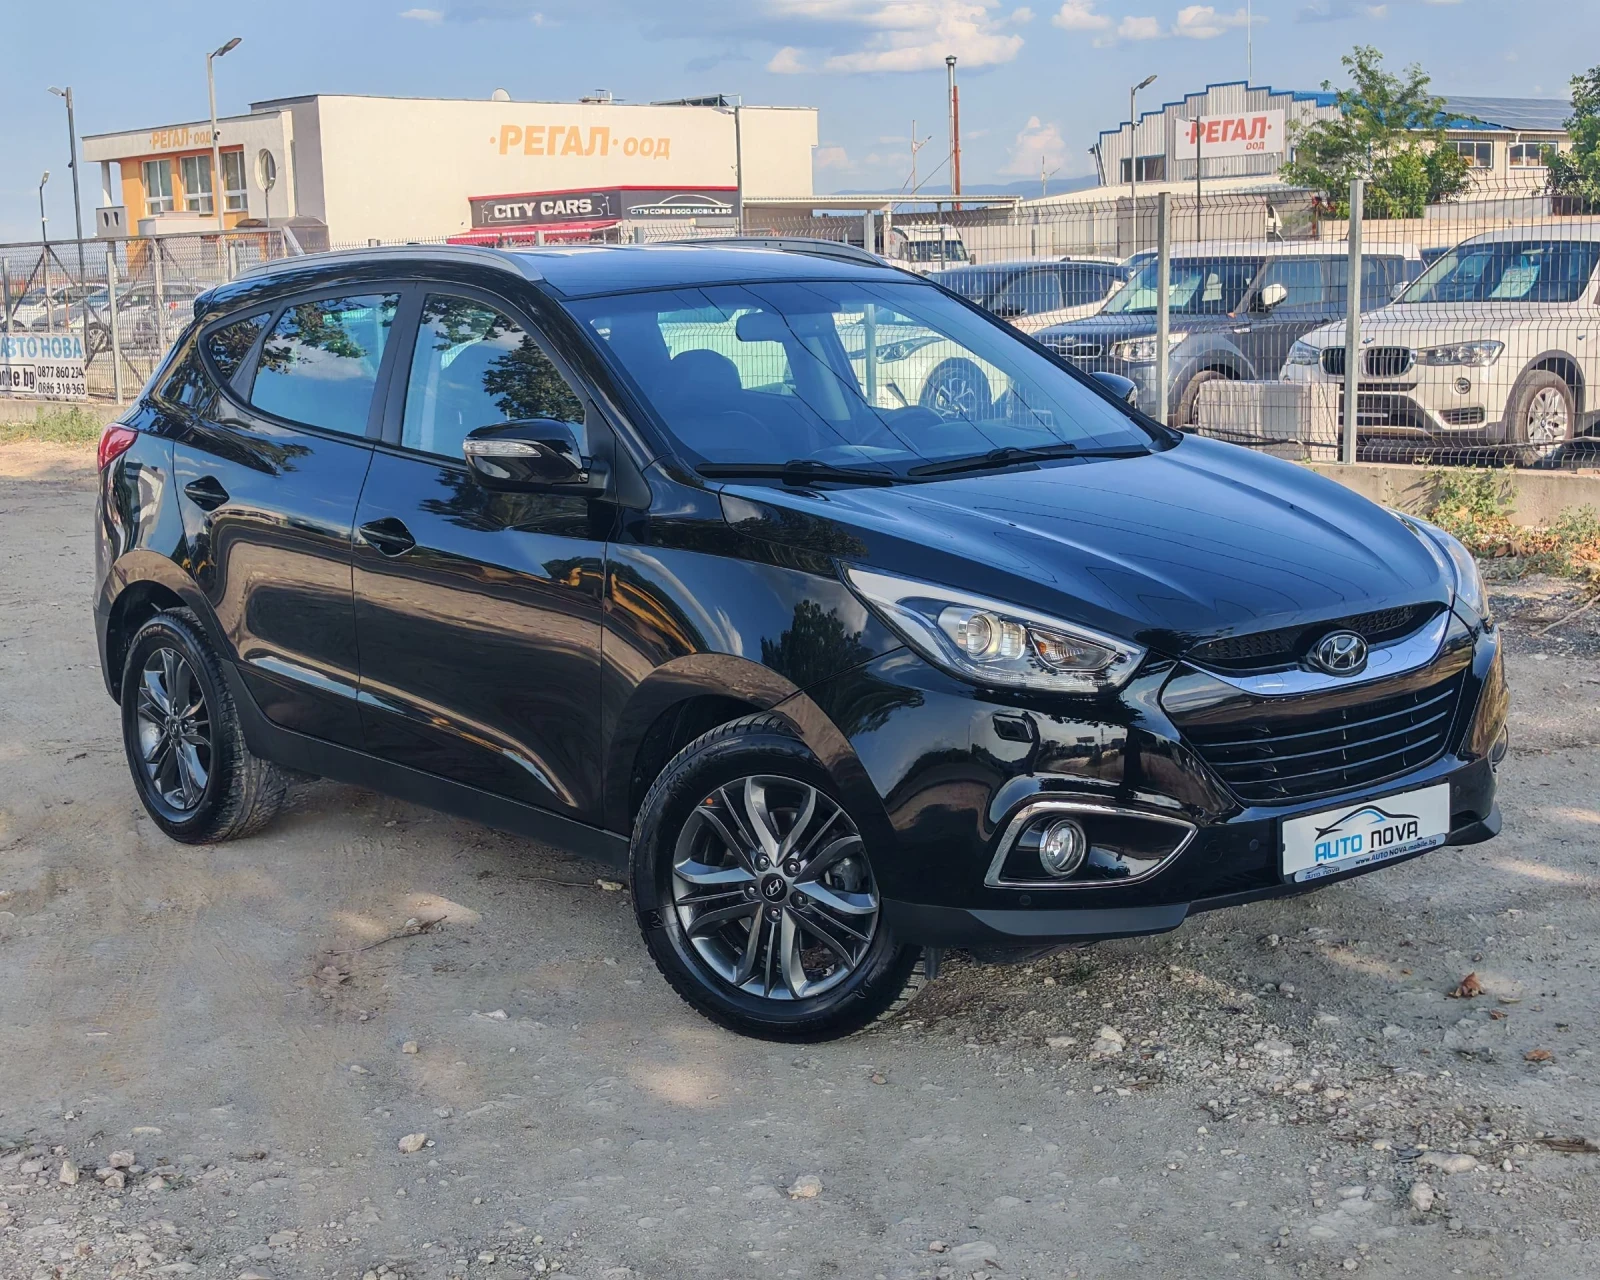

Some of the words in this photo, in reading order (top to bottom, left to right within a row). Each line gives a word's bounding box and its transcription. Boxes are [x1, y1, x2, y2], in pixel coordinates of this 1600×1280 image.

[493, 202, 536, 218] CITY
[540, 199, 592, 215] CARS
[0, 336, 37, 358] АВТО
[40, 336, 83, 358] НОВА
[37, 365, 55, 378] 0877
[55, 366, 70, 379] 860
[71, 383, 86, 395] 363
[1315, 834, 1363, 862] AUTO
